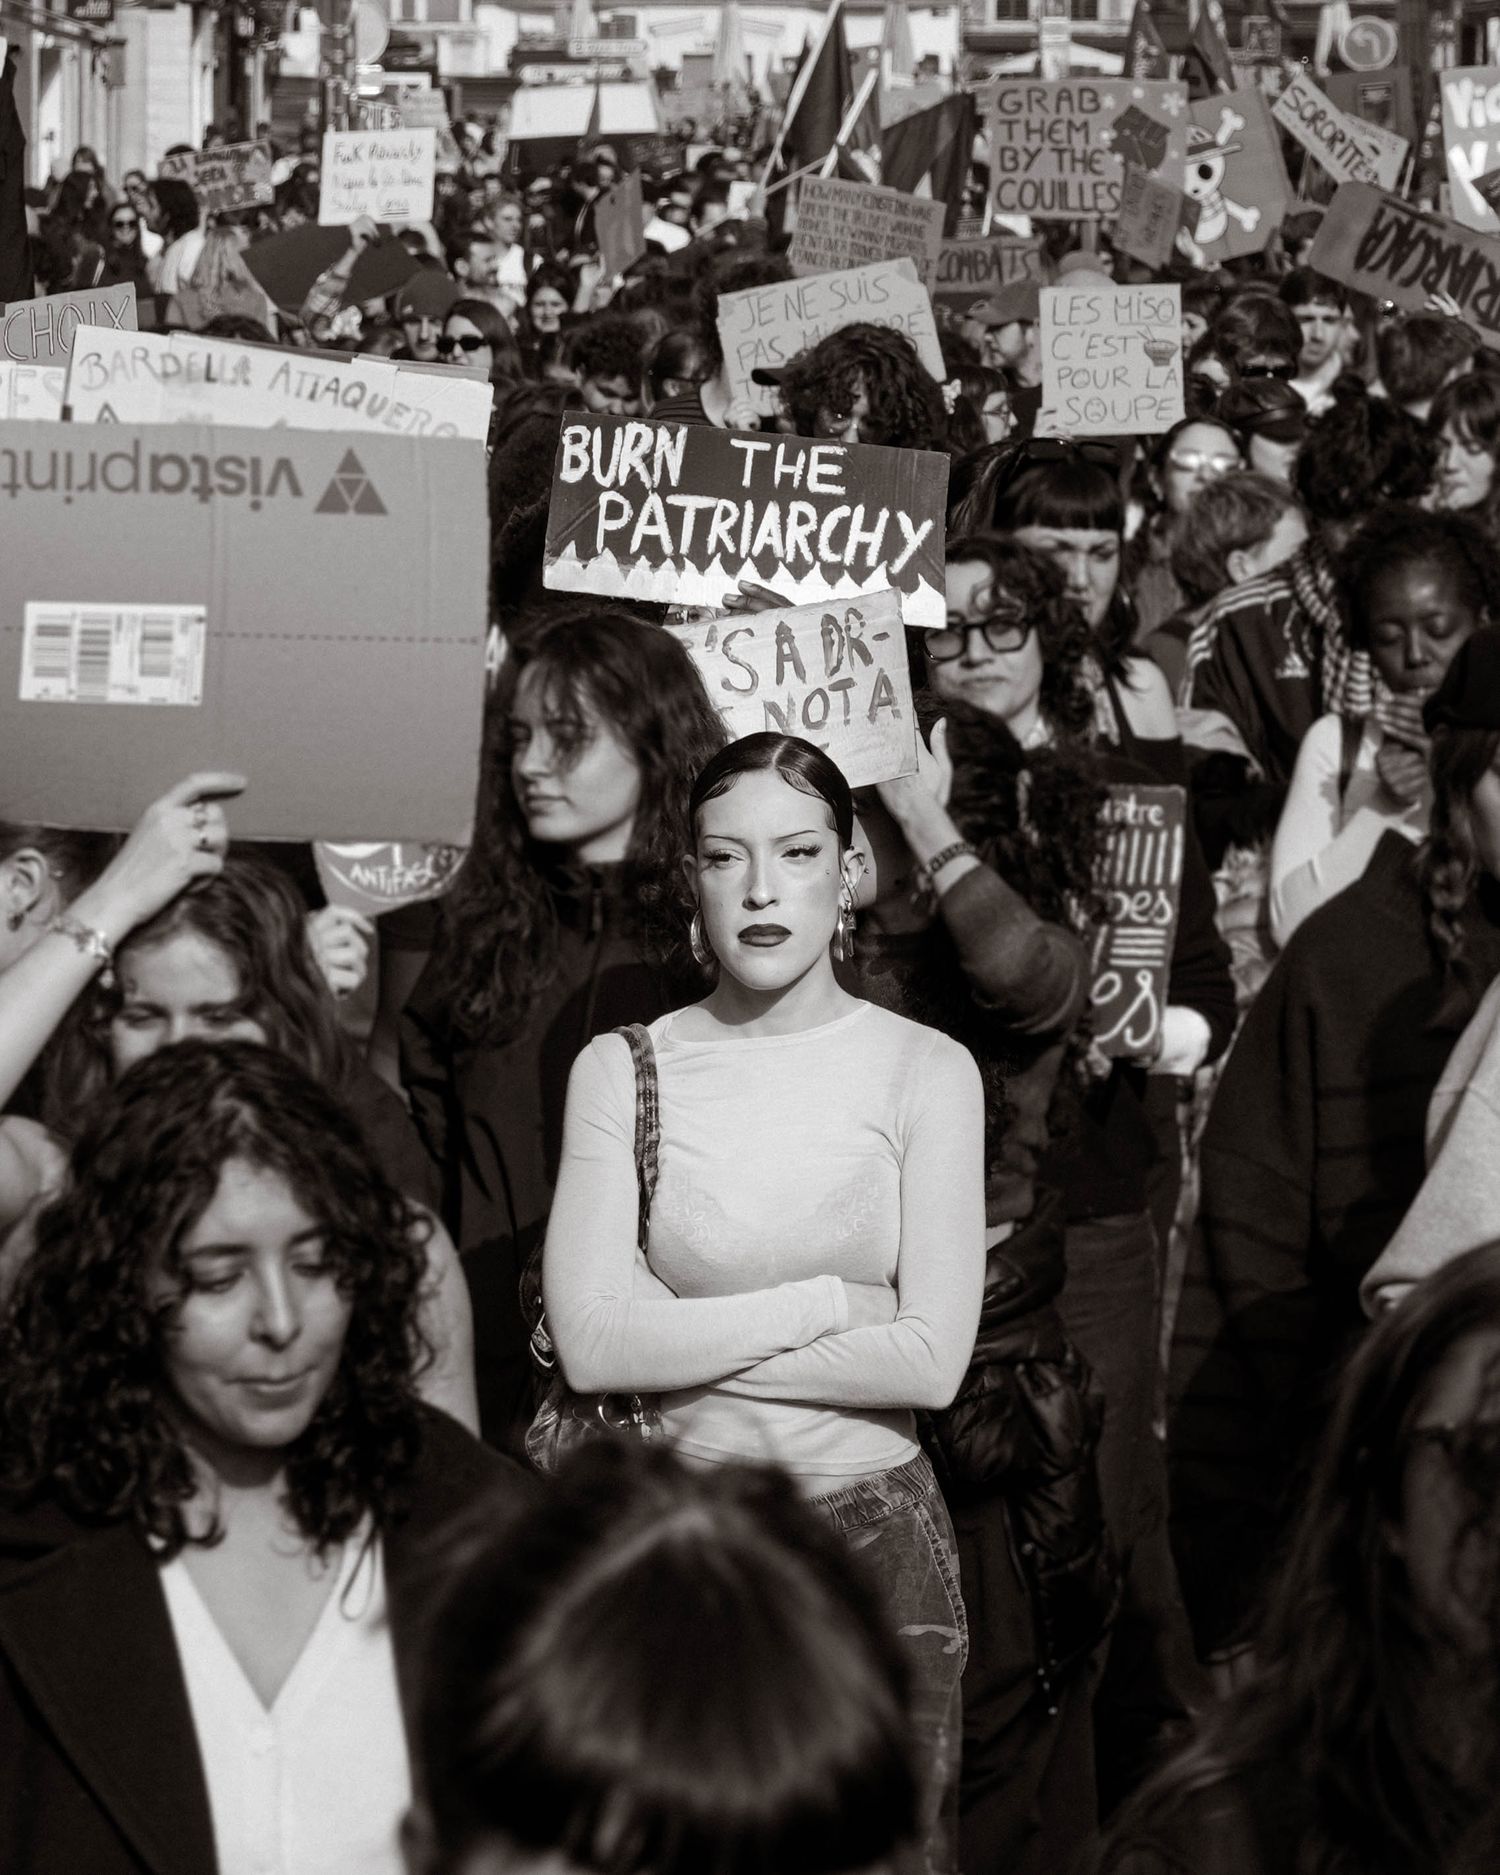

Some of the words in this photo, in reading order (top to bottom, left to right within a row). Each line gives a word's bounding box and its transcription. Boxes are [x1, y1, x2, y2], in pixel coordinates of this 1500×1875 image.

[998, 86, 1100, 115] GRAB
[998, 118, 1090, 145] THEM
[1000, 146, 1042, 173] BY
[1050, 147, 1105, 176] THE
[997, 179, 1121, 212] COUILLES
[738, 288, 777, 333] JE
[784, 281, 820, 322] NE
[1052, 295, 1103, 326] LES
[736, 335, 786, 372] PAS
[1051, 330, 1140, 361] C'EST
[1057, 365, 1132, 390] POUR
[1145, 368, 1179, 390] LA
[1064, 394, 1177, 426] SOUPE
[0, 438, 304, 511] vistaprint
[560, 421, 689, 488] BURN
[730, 438, 848, 496] THE
[595, 489, 934, 574] PATRIARCHY
[867, 668, 902, 726] A
